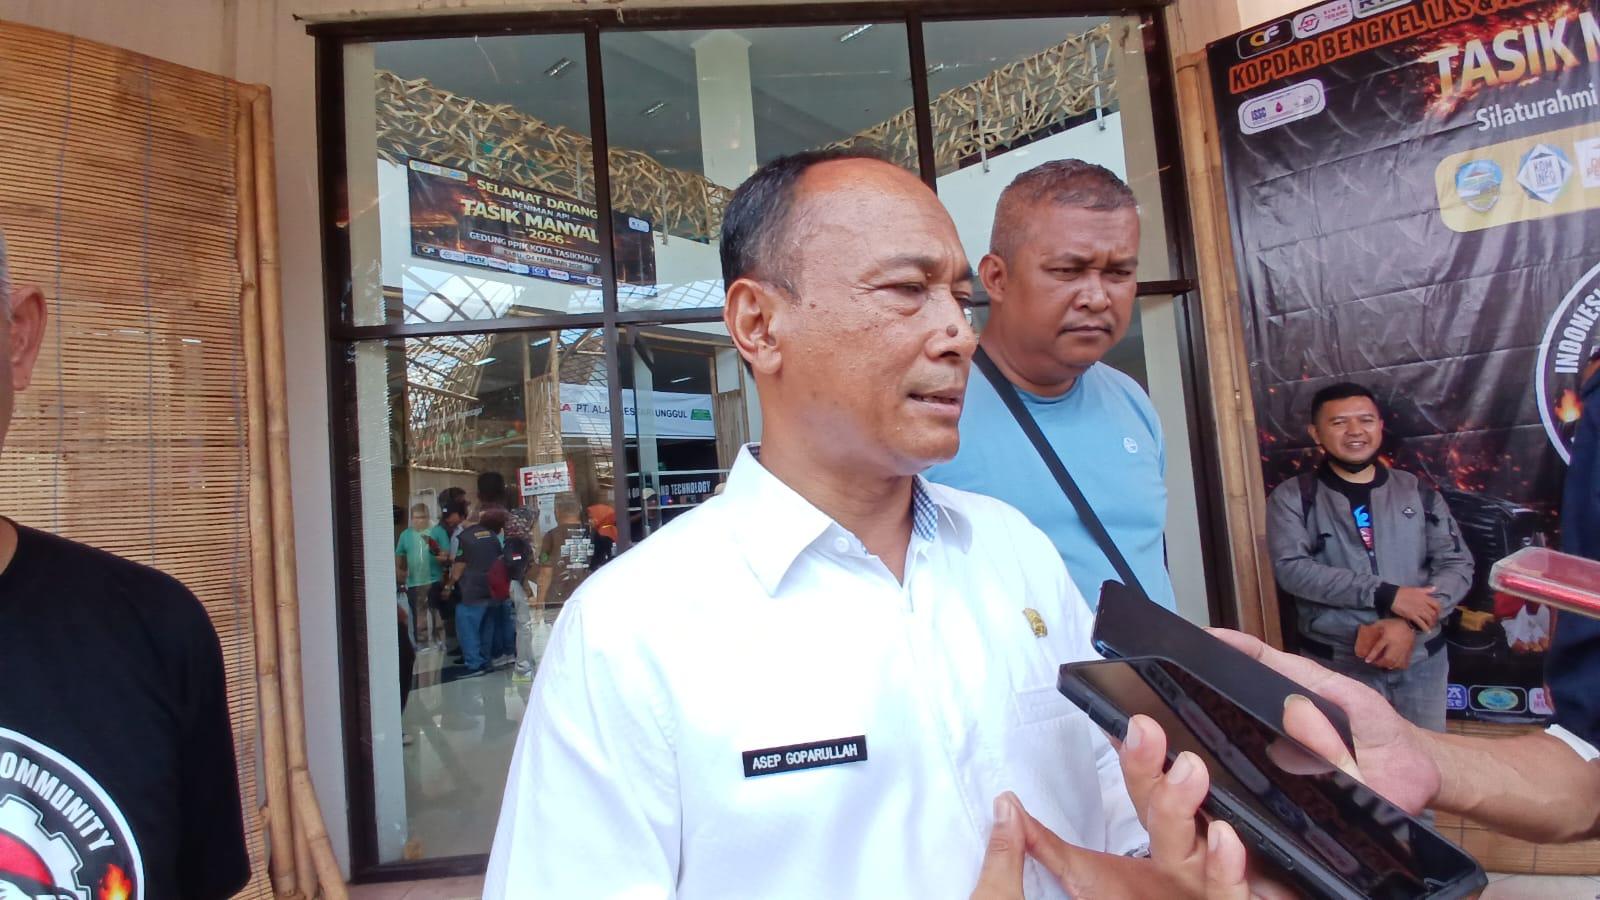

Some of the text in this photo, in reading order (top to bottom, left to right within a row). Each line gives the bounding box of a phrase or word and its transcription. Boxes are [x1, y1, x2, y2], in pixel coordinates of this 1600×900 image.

[1232, 43, 1316, 91] KOPDAR
[1323, 11, 1423, 60] BENGKEL
[1428, 0, 1471, 24] LAS
[1421, 16, 1580, 99] TASIK
[1476, 82, 1598, 131] Silaturahmi
[476, 180, 598, 219] SELAMAT DATANG
[512, 201, 570, 220] SENIMAN API
[461, 199, 520, 225] TASIK
[525, 212, 600, 244] MANYAL
[469, 231, 601, 264] GEDUNG PPIK KOTA TASIKMALA
[1554, 288, 1600, 374] INDONES
[655, 409, 688, 418] UNGGUL
[671, 480, 711, 495] TECHNOLOGY
[752, 743, 858, 770] ASEP GOPARULLAH
[0, 752, 115, 851] OMMUNITY
